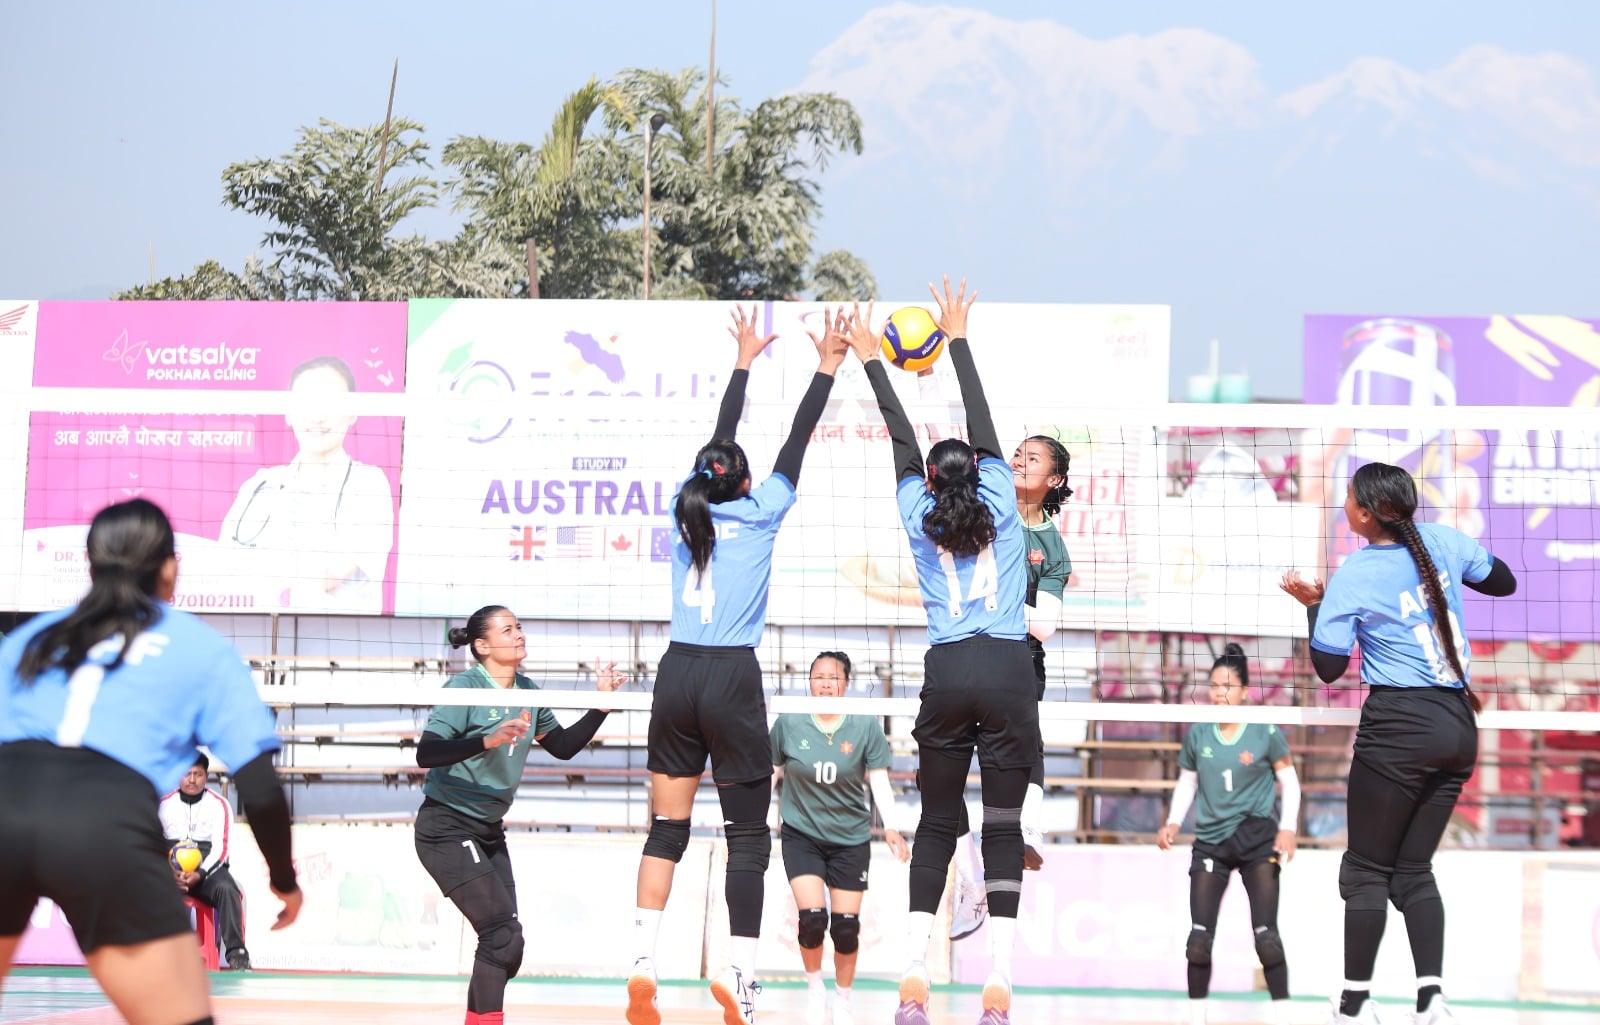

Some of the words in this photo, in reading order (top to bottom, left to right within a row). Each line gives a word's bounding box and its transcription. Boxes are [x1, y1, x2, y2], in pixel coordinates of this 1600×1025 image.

[145, 341, 256, 368] vatsalya
[146, 369, 211, 381] POKHARA
[214, 369, 257, 381] CLINIC
[54, 429, 80, 446] अब
[135, 426, 183, 446] पोखरा
[576, 458, 609, 470] STUDY
[612, 458, 624, 470] IN
[481, 479, 680, 516] AUSTRAL
[54, 551, 78, 562] DR.
[682, 553, 716, 624] 4
[937, 541, 999, 618] 14
[813, 761, 837, 784] 10
[1222, 769, 1233, 792] 1
